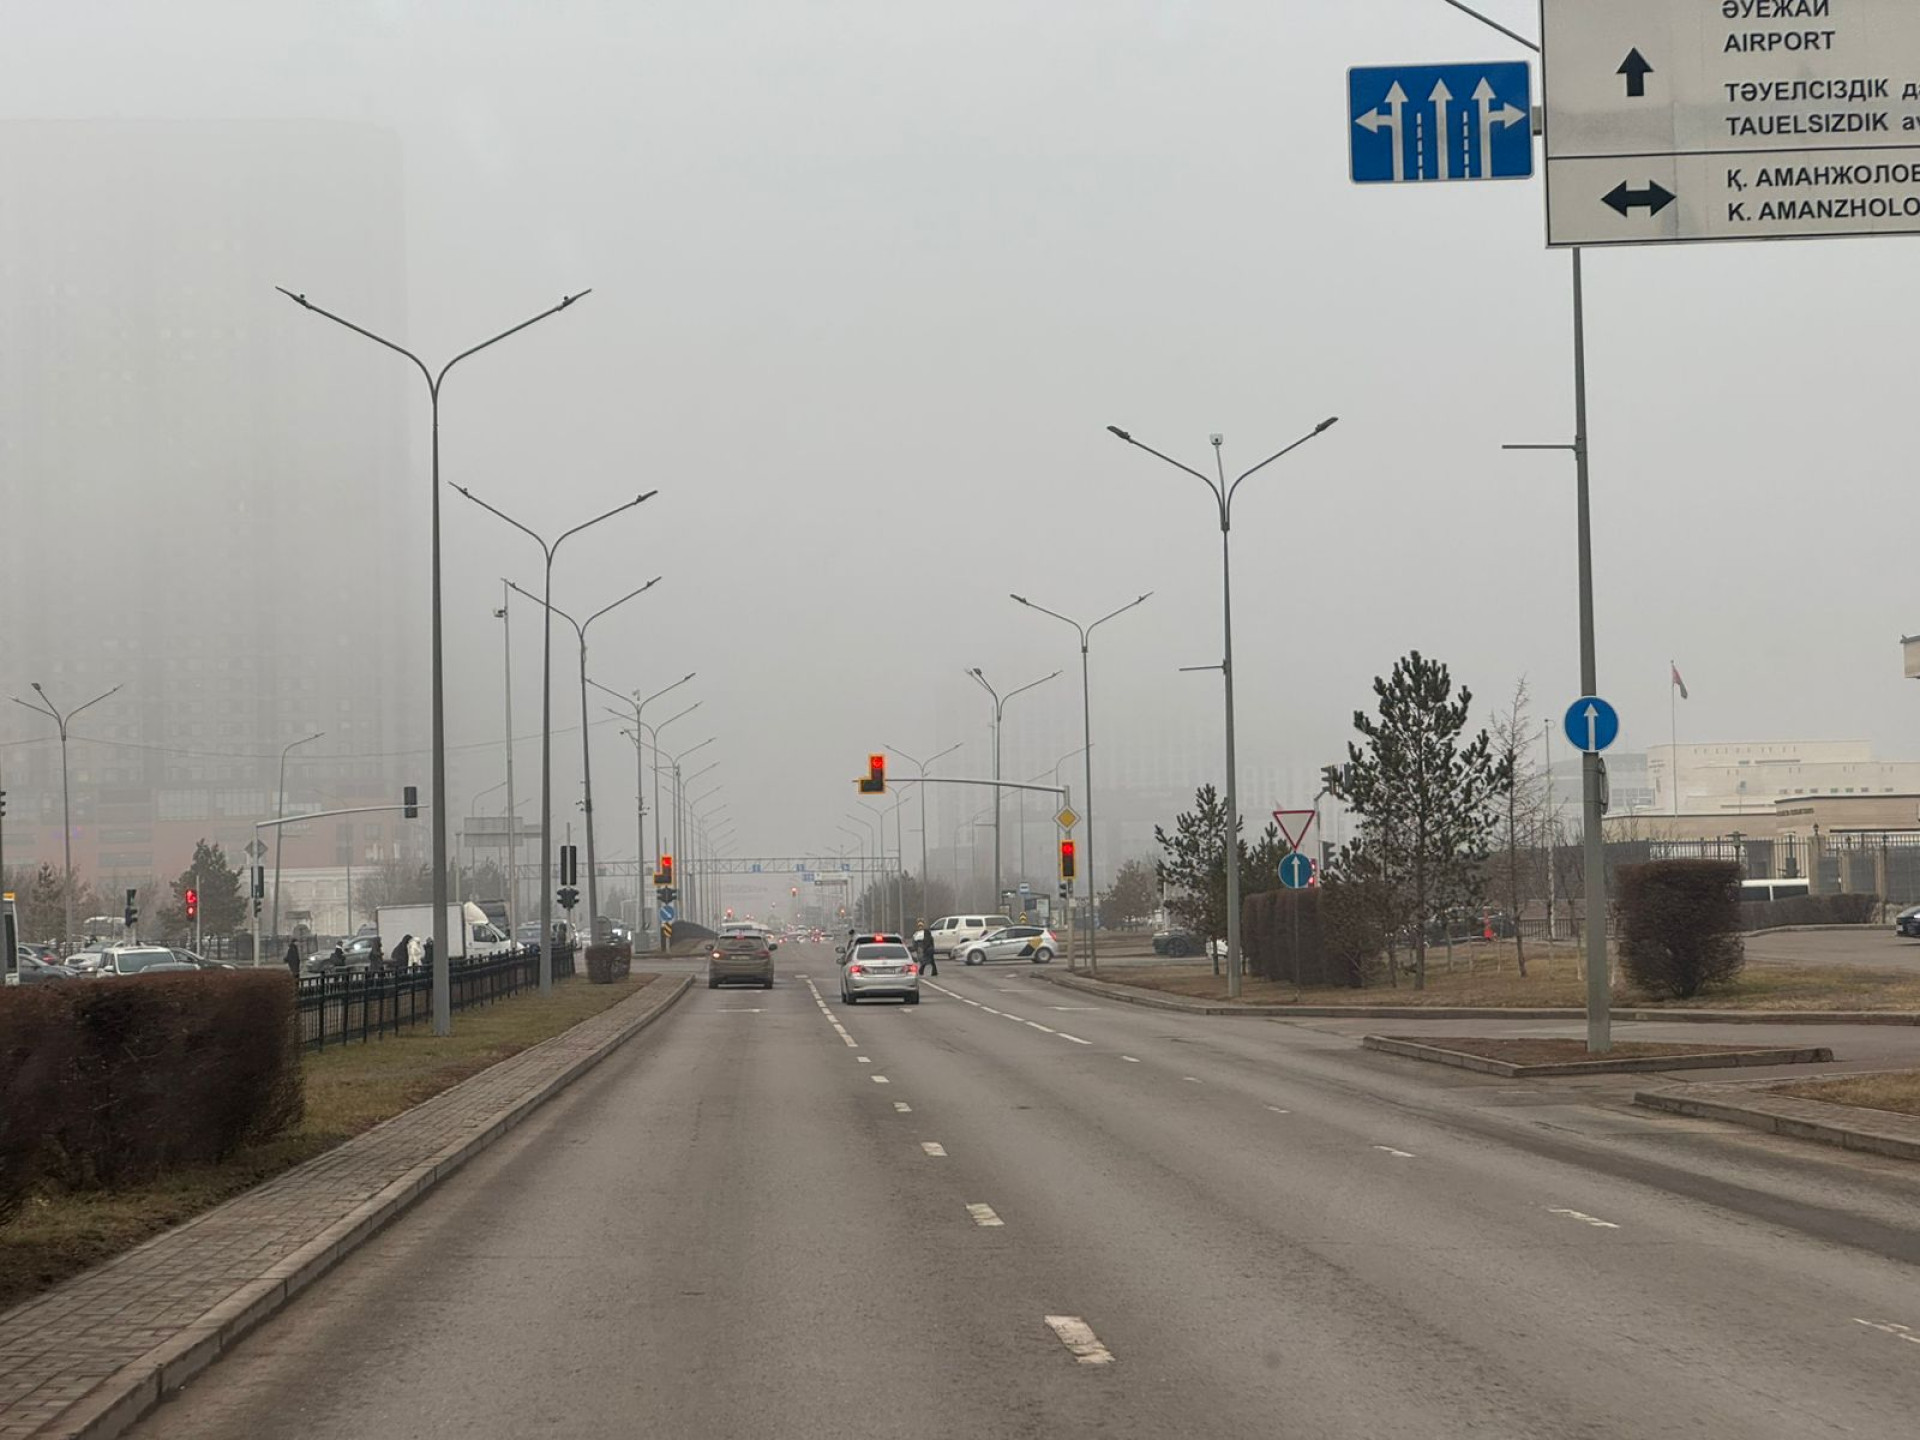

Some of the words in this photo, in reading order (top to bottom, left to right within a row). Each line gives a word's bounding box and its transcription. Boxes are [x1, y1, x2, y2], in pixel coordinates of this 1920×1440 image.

[1723, 31, 1836, 52] AIRPORT
[1724, 78, 1889, 102] ТӘУЕЛСІЗДІК
[1901, 82, 1920, 101] д
[1725, 112, 1889, 136] TAUELSIZDIK
[1728, 201, 1752, 222] K.
